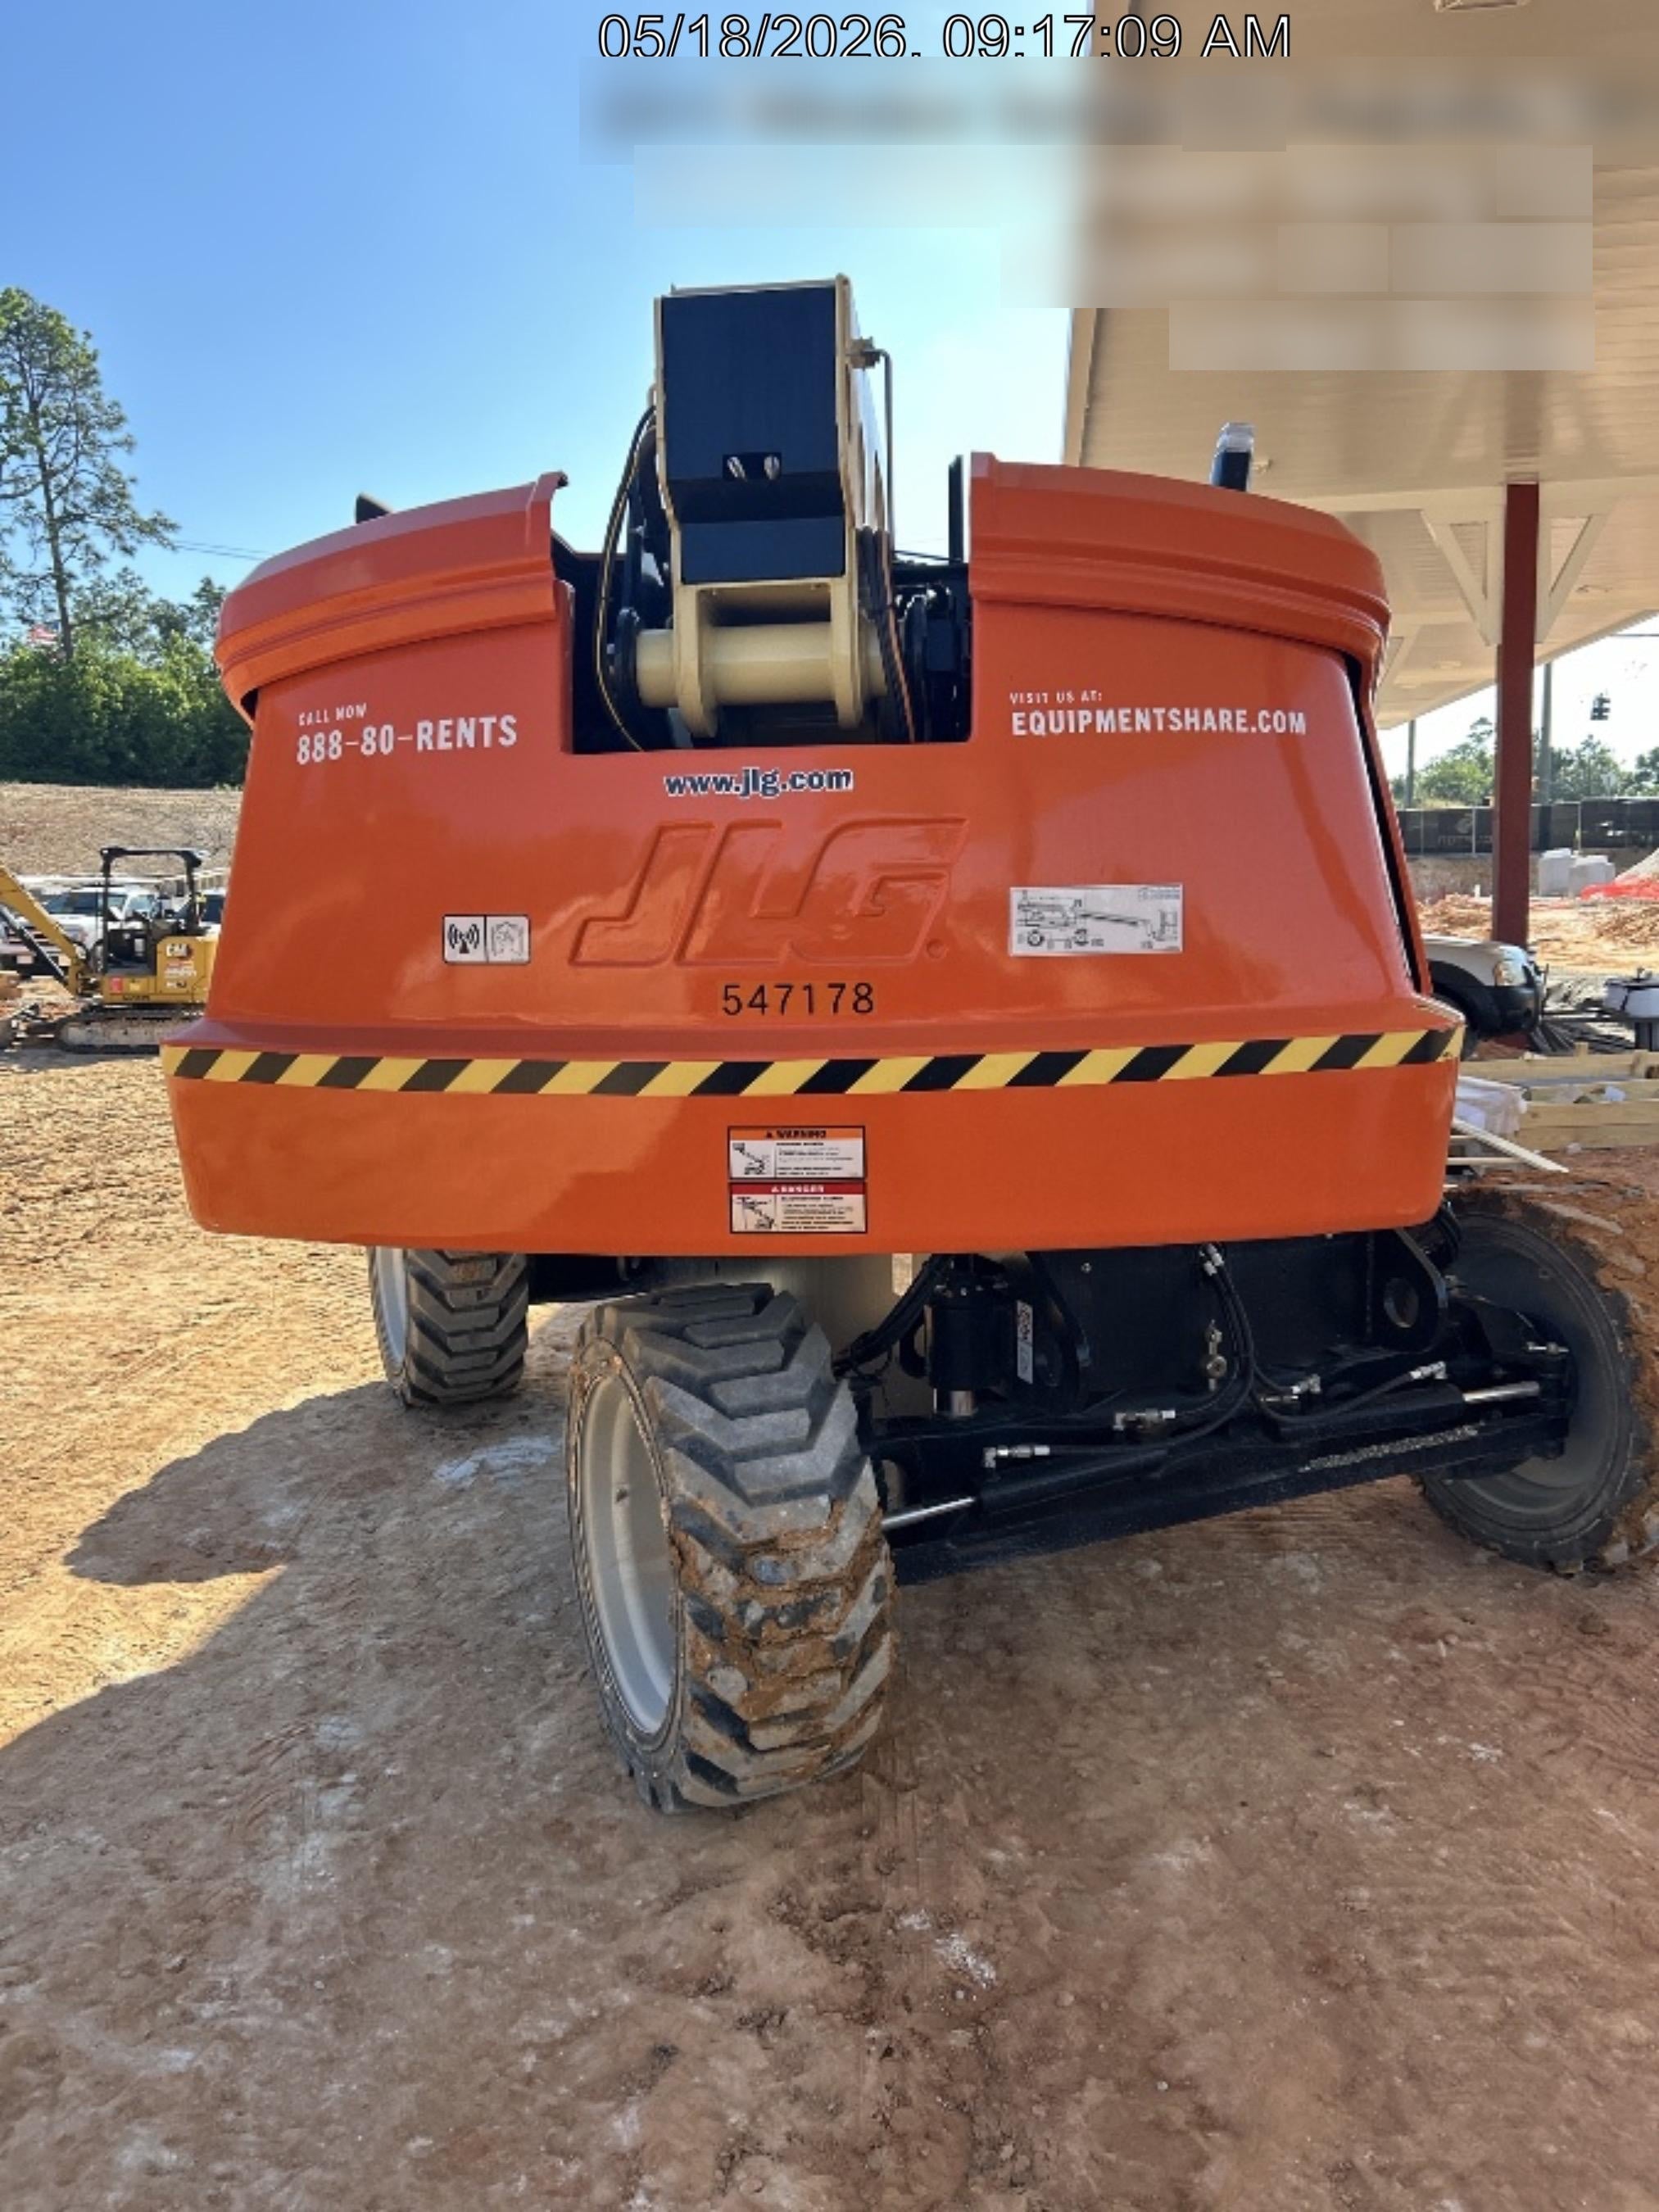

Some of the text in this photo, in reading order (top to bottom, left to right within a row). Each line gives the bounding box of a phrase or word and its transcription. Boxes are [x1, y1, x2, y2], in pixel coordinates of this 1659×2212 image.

[1009, 690, 1102, 705] VISIT US AT:
[298, 702, 367, 726] CALL NOW
[1011, 708, 1307, 736] EQUIPMENTSHARE.COM
[297, 714, 518, 765] 888-80-RENTS
[664, 767, 854, 799] www.jlg.com
[723, 983, 874, 1015] 547178
